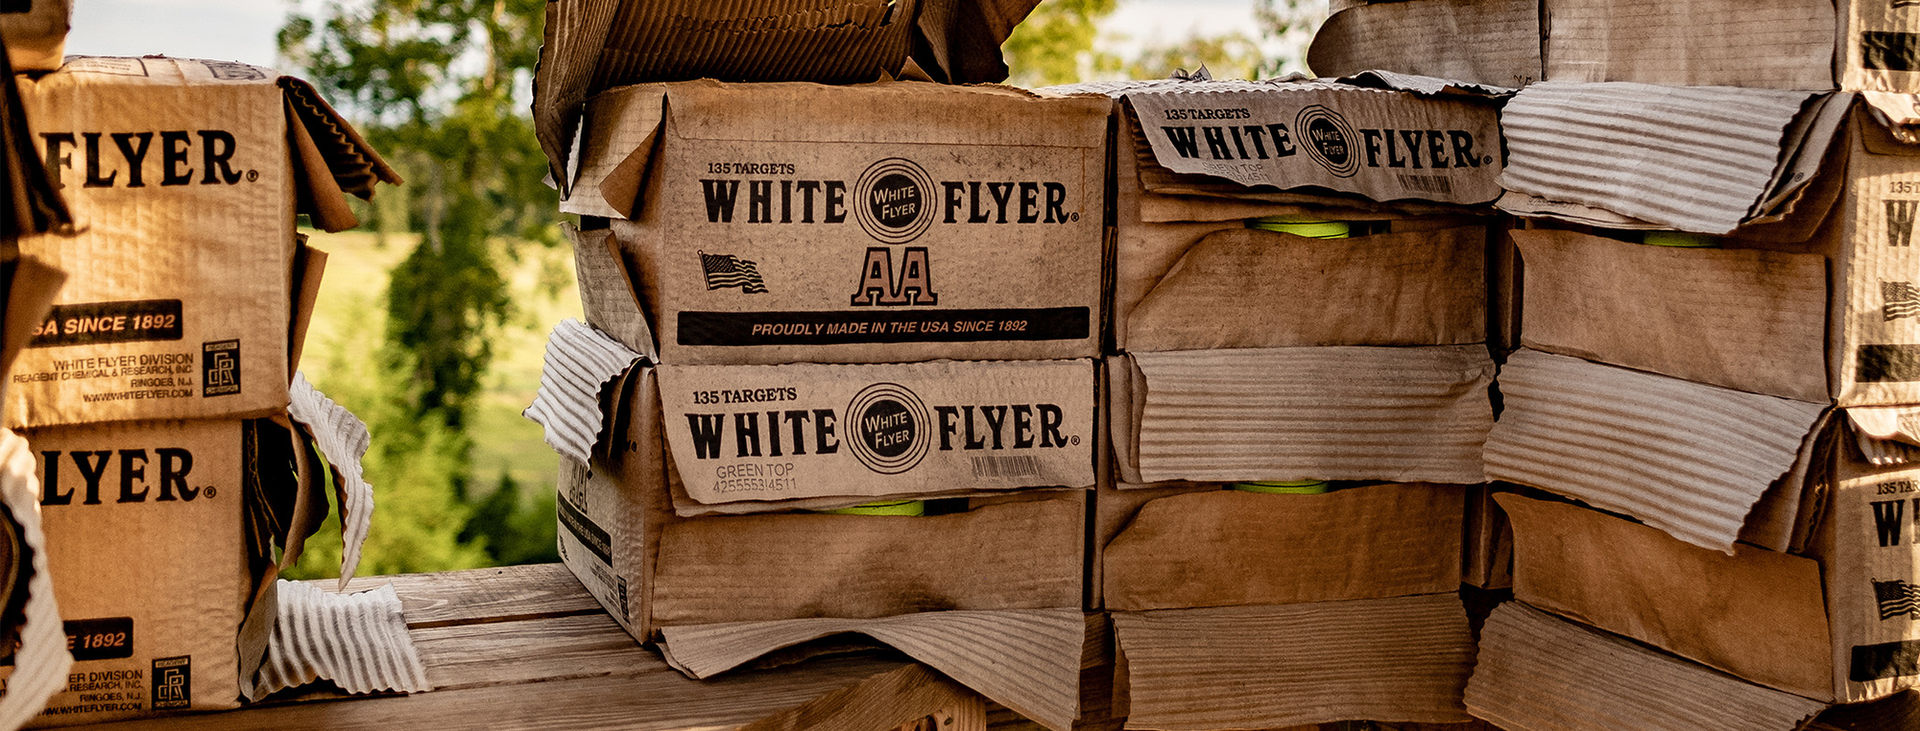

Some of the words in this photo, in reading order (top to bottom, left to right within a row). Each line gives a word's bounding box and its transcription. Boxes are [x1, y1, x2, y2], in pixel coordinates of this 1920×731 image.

[1164, 108, 1187, 120] 135
[1188, 108, 1250, 120] TARGETS
[1161, 123, 1298, 159] WHITE
[1312, 128, 1340, 141] WHITE
[707, 162, 731, 175] 135
[732, 162, 795, 175] TARGETS
[1240, 163, 1263, 173] TOP
[873, 185, 915, 205] WHITE
[1889, 181, 1911, 194] 135
[699, 179, 848, 224] WHITE
[881, 202, 917, 220] FLYER
[851, 247, 938, 306] AA
[32, 322, 58, 336] SA
[64, 316, 127, 334] SINCE
[133, 314, 175, 330] 1892
[751, 323, 825, 336] PROUDLY
[826, 322, 868, 335] MADE
[871, 322, 887, 334] IN
[890, 321, 916, 333] THE
[920, 321, 949, 333] USA
[953, 320, 994, 332] SINCE
[999, 320, 1028, 332] 1892
[53, 357, 95, 371] WHITE
[98, 355, 136, 367] FLYER
[140, 353, 194, 365] DIVISION
[13, 371, 59, 383] REAGENT
[61, 369, 109, 381] CHEMICAL
[111, 368, 118, 377] &
[693, 390, 719, 404] 135
[721, 387, 797, 403] TARGETS
[865, 411, 908, 432] WHITE
[684, 408, 840, 459] WHITE
[875, 428, 910, 449] FLYER
[39, 447, 200, 506] LYER
[716, 463, 764, 479] GREEN
[767, 462, 794, 477] TOP
[1877, 481, 1897, 495] 135
[83, 632, 126, 648] 1892
[89, 669, 143, 681] DIVISION
[40, 703, 142, 716] WW.WHITEFLYER.COM
